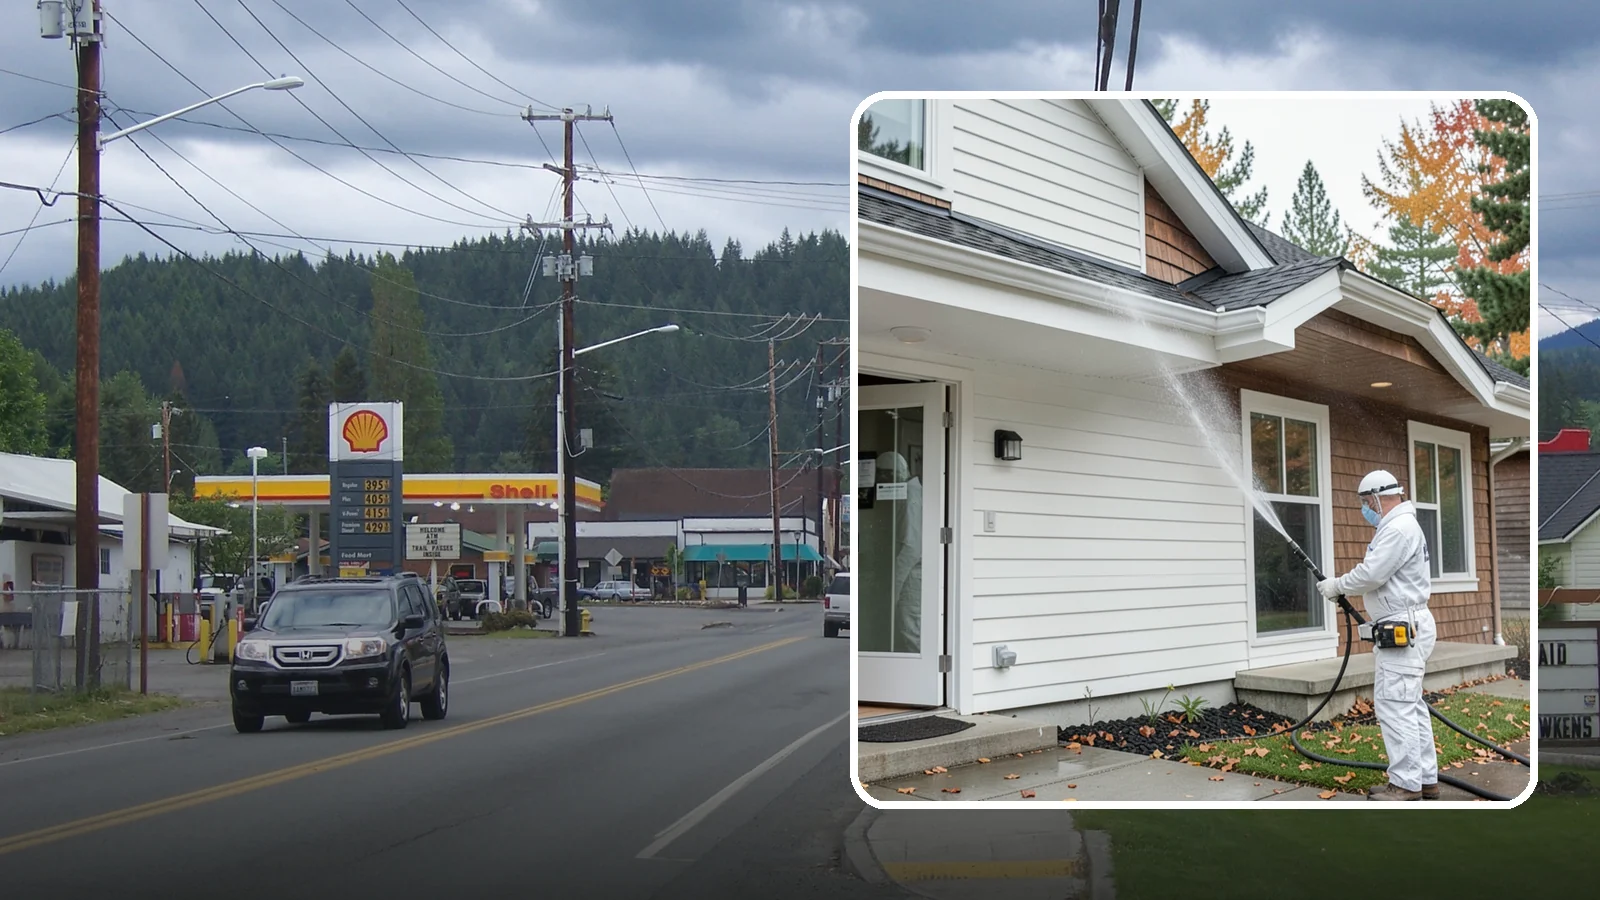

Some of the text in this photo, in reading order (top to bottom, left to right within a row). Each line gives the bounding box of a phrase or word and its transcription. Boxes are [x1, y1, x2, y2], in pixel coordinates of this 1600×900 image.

[366, 480, 383, 490] 395
[490, 484, 547, 499] Shell
[366, 494, 383, 504] 405
[366, 508, 383, 518] 415
[366, 522, 383, 533] 429
